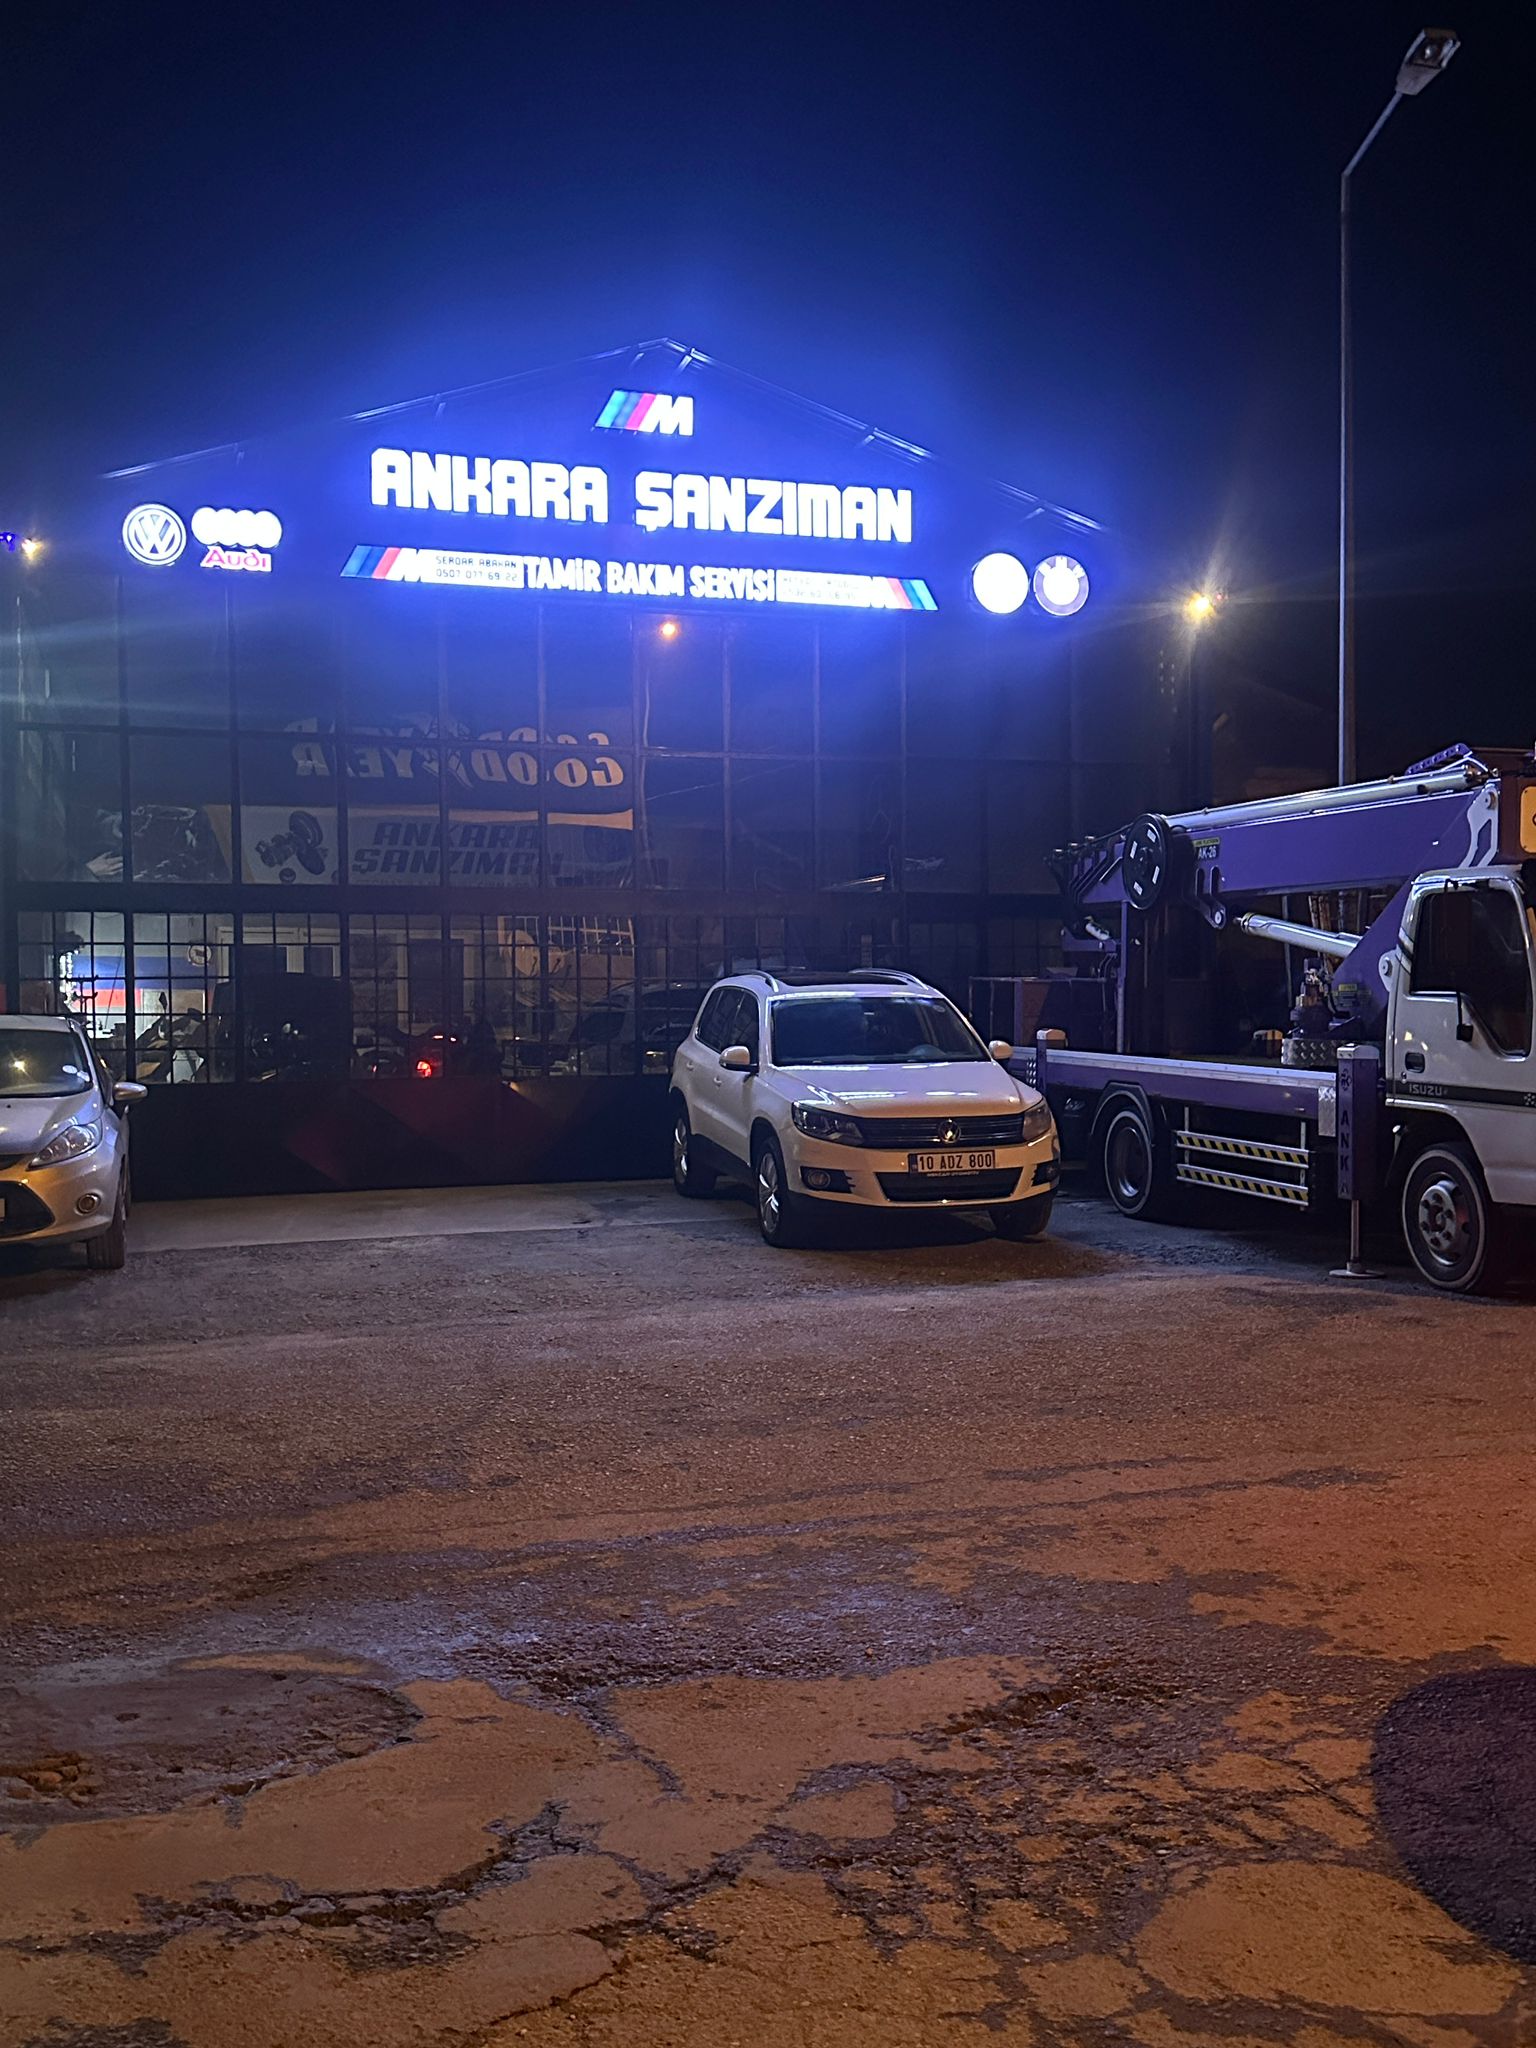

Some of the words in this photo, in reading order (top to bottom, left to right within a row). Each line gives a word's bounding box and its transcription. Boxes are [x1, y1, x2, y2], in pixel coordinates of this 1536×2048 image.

[638, 395, 694, 436] M
[371, 448, 608, 523] ANKARA
[635, 471, 912, 544] ŞANZIMAN
[206, 549, 266, 568] Audi
[607, 561, 685, 597] BAKIM
[1409, 1084, 1442, 1096] ISUZU
[919, 1156, 934, 1170] 10
[940, 1155, 963, 1169] ADZ
[969, 1153, 992, 1168] 800
